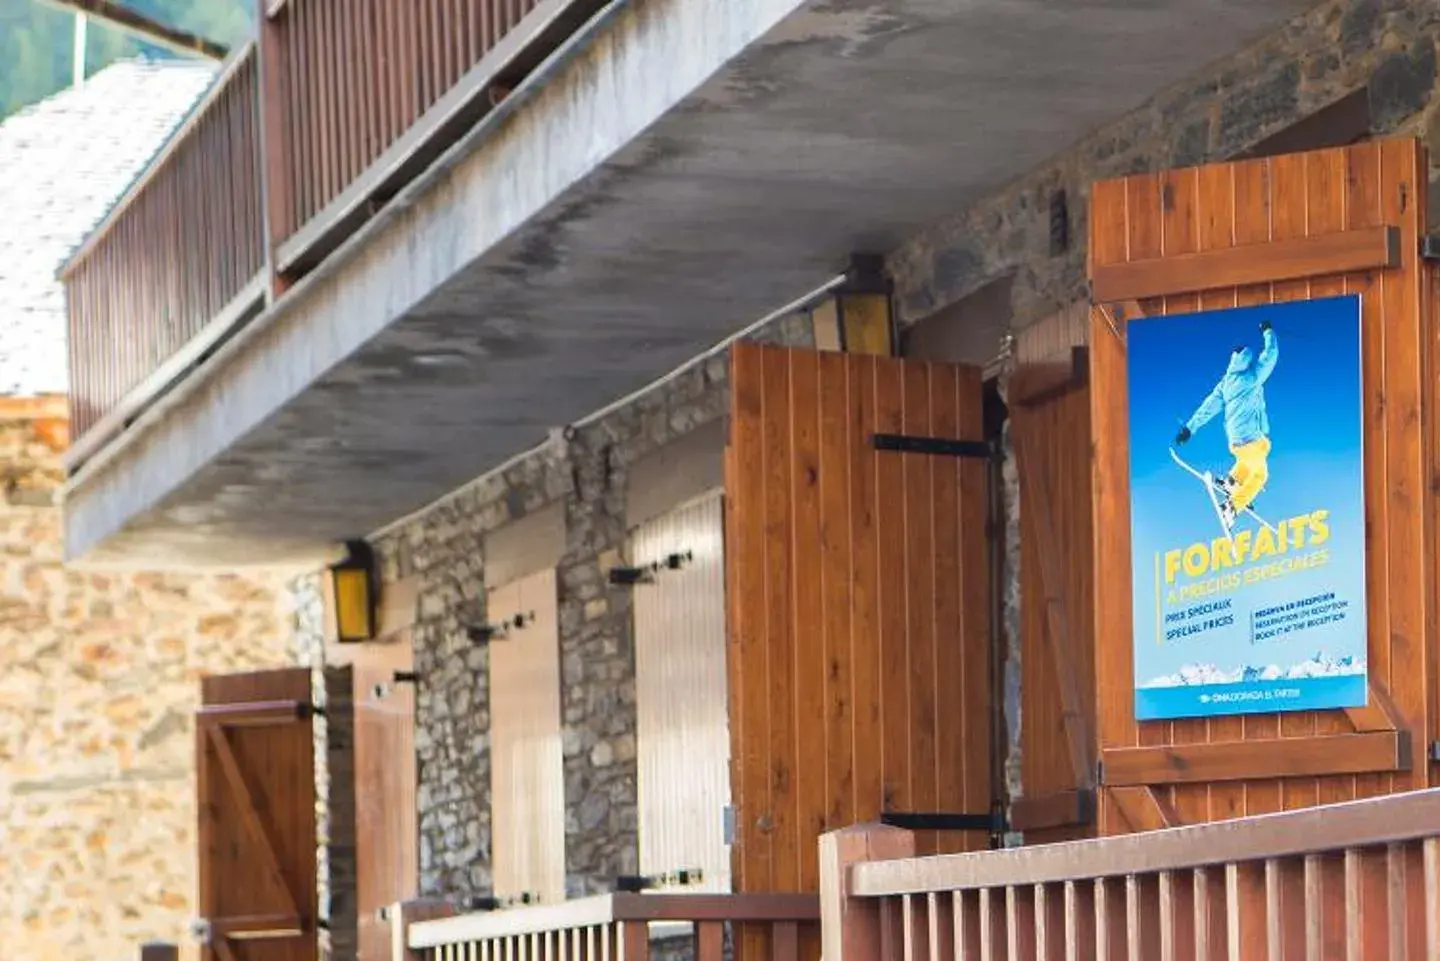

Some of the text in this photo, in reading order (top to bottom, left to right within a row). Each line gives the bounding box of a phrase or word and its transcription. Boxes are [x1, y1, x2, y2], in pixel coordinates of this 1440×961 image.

[1165, 510, 1330, 584] FORFAITS
[1167, 549, 1330, 604] A PRECIOS ESPECIALES
[1166, 613, 1234, 640] SPECIAL PRICES
